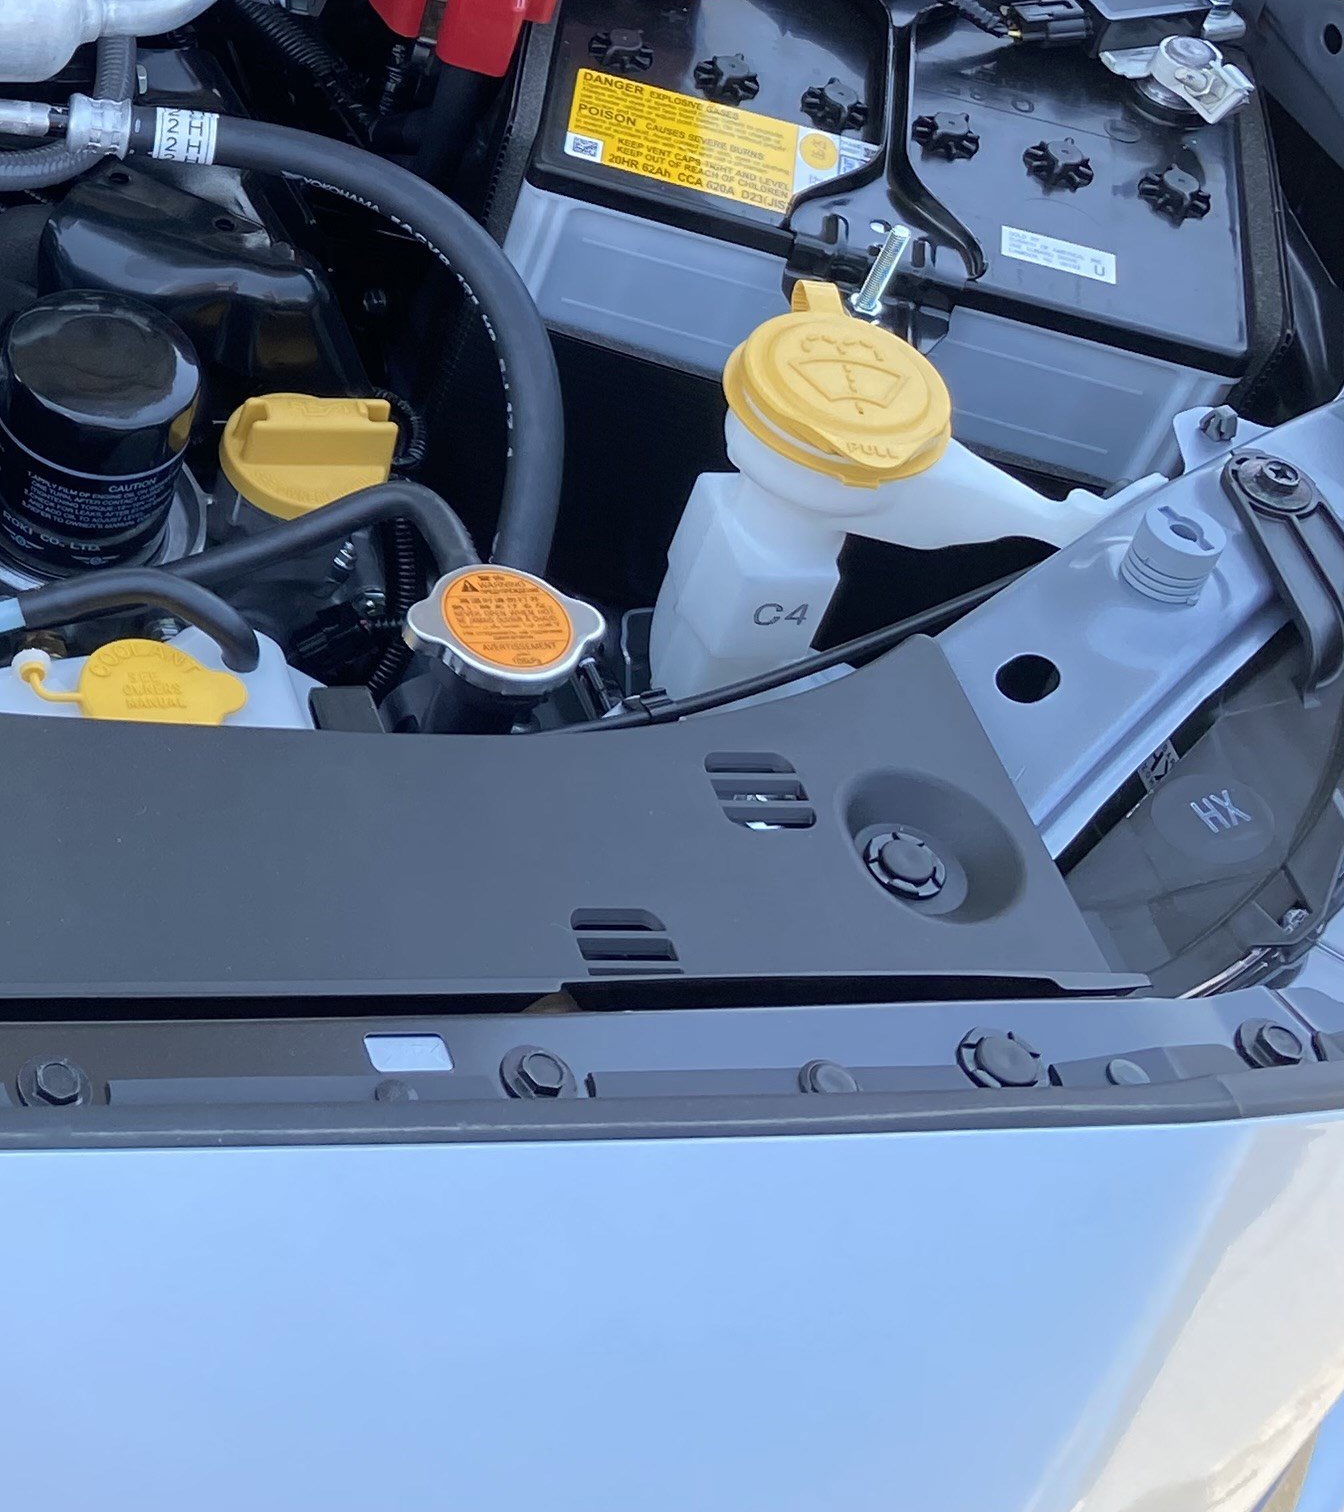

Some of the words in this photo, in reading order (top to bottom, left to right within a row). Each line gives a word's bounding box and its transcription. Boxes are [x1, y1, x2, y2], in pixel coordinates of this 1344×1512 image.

[583, 71, 645, 96] DANGER
[649, 90, 704, 111] EXPLOSIVE
[577, 103, 637, 127] POISON
[645, 122, 686, 139] CAUSES
[687, 133, 727, 150] SEVERE
[616, 146, 643, 159] KEEP
[645, 153, 666, 165] OUT
[668, 160, 681, 169] OF
[684, 164, 719, 179] REACH
[721, 174, 736, 184] OF
[617, 138, 644, 151] KEEP
[646, 145, 672, 158] VENT
[674, 153, 702, 166] CAPS
[607, 154, 640, 170] 20HR
[641, 163, 672, 179] 62Ah
[677, 172, 704, 187] CCA
[1094, 264, 1106, 277] U
[845, 440, 900, 460] PULL
[108, 477, 157, 493] CAUTION
[2, 510, 33, 536] ROKI
[753, 602, 809, 626] C4
[89, 642, 202, 678] COOLANT
[127, 671, 159, 684] SEE
[125, 697, 188, 709] MANUAL
[1190, 790, 1252, 833] HX
